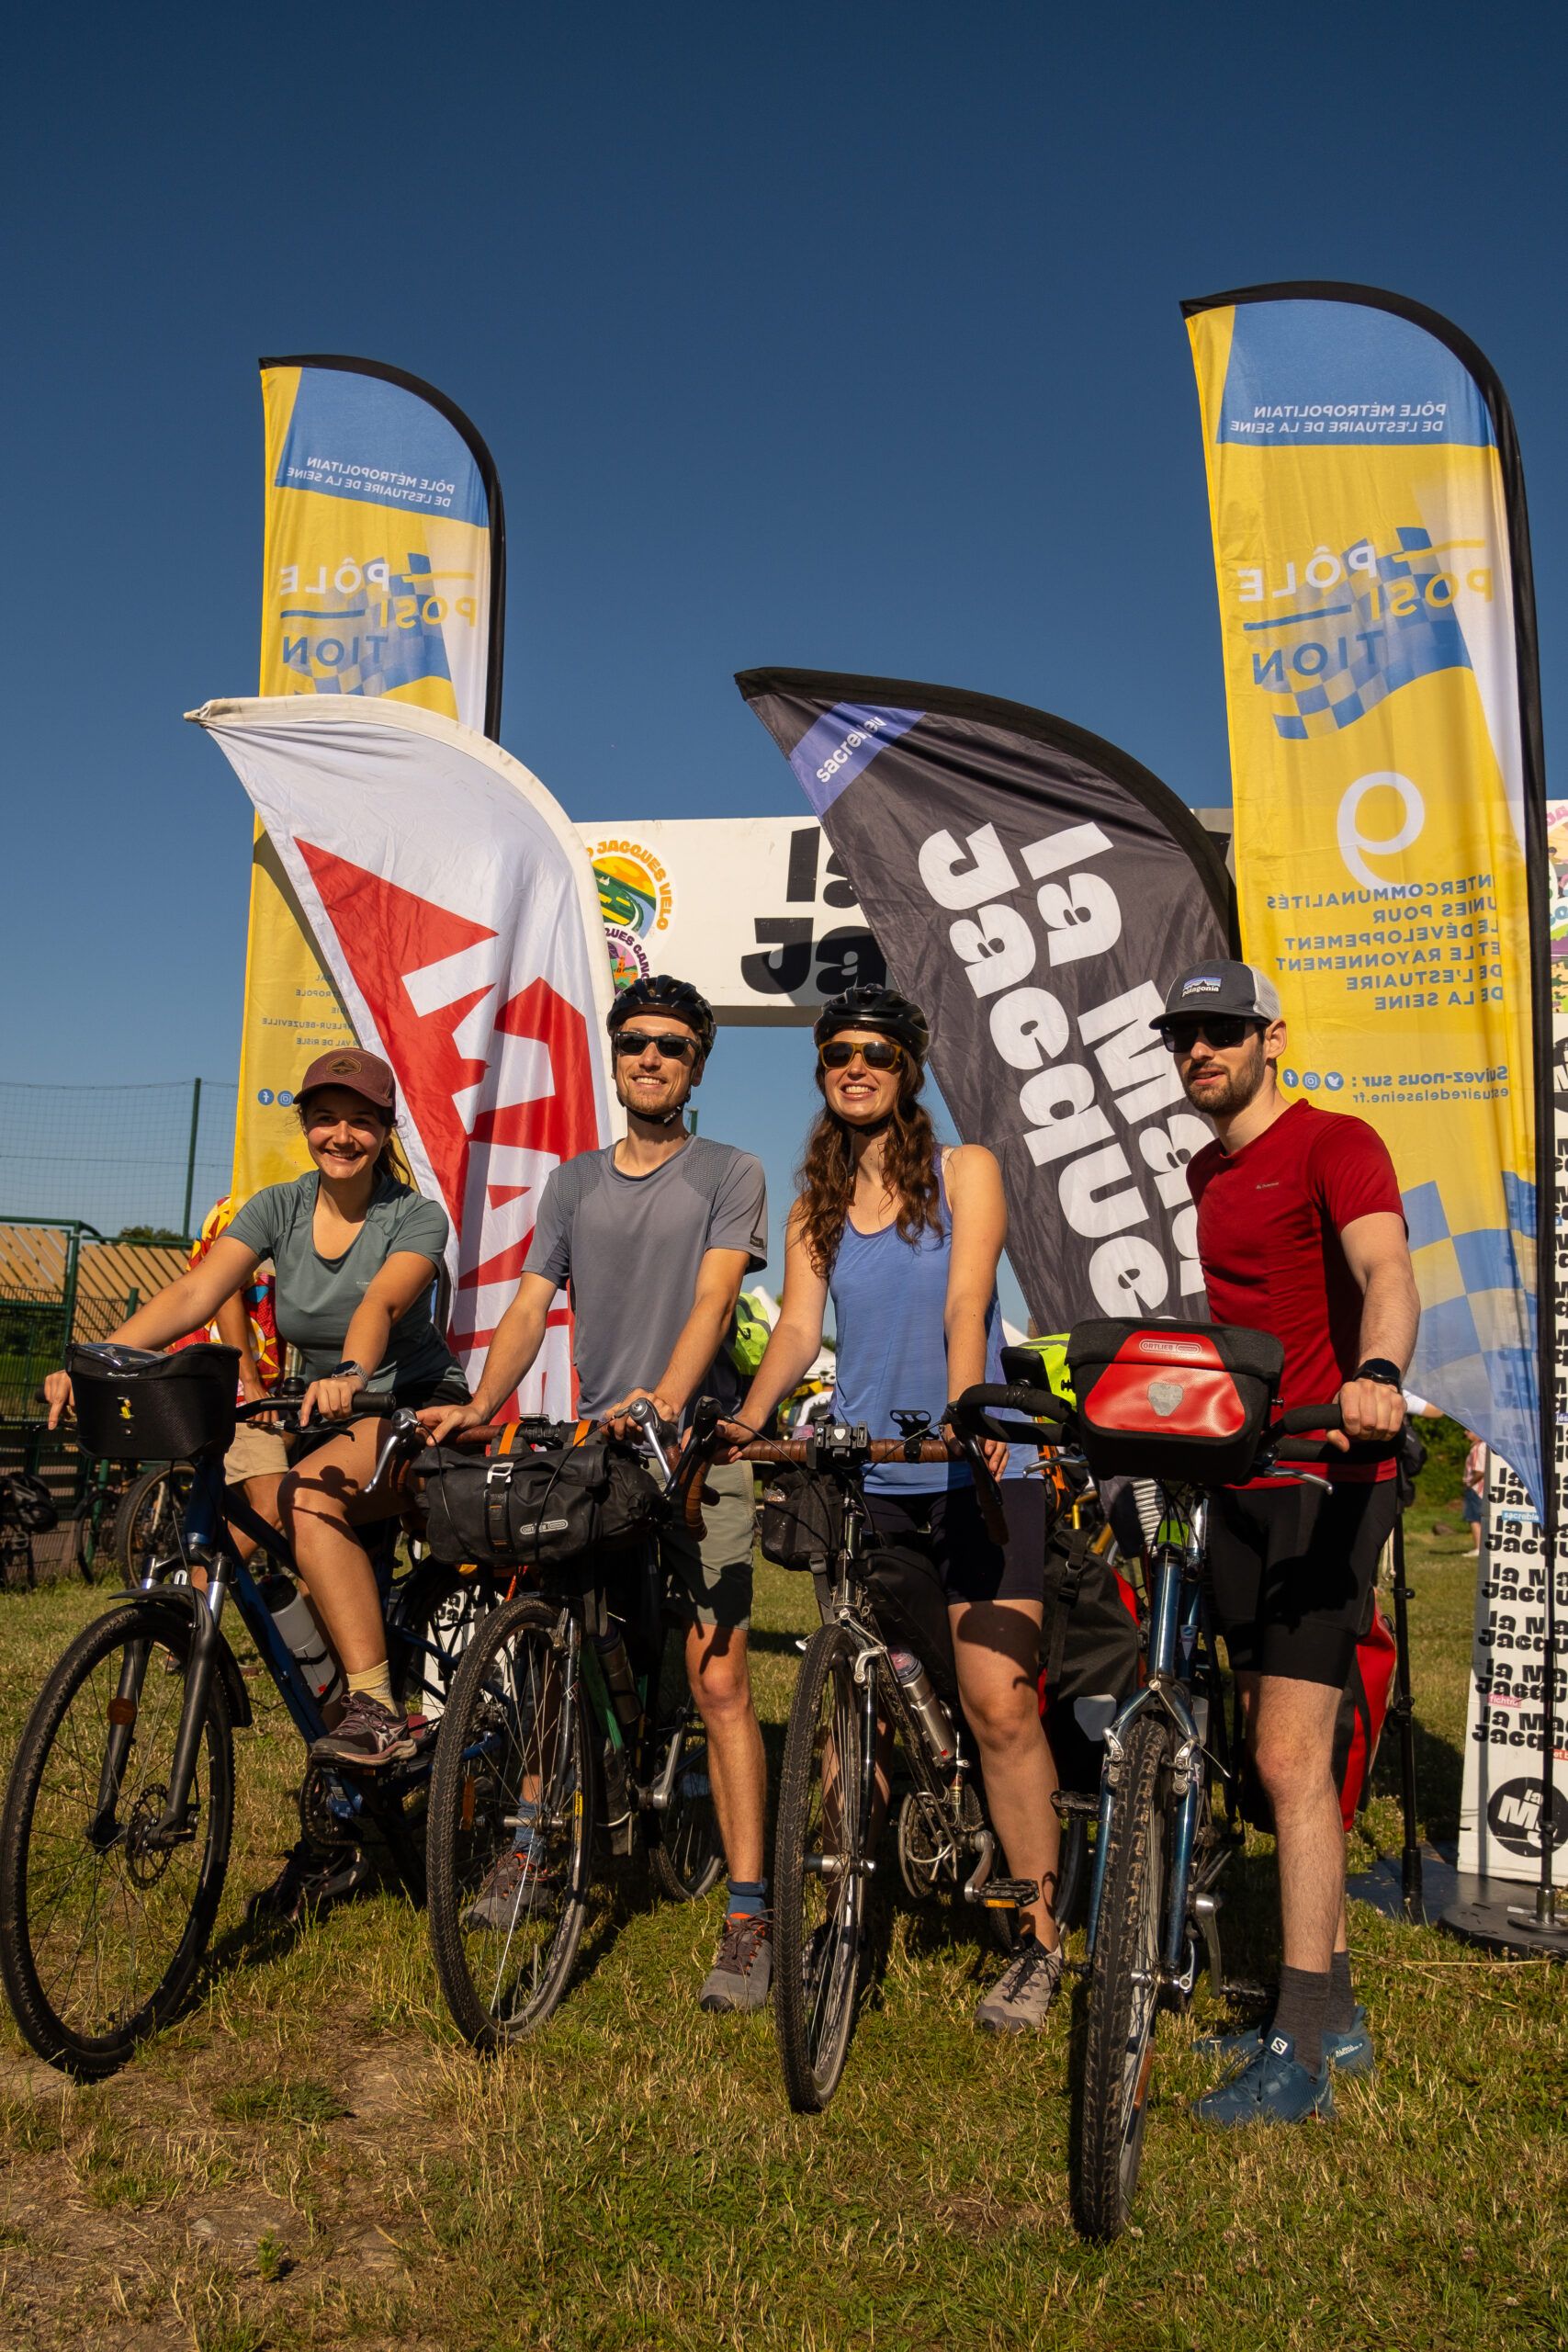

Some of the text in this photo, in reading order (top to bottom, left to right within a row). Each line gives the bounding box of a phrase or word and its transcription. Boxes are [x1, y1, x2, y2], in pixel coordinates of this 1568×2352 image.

[596, 841, 666, 882] JACQUES
[1020, 822, 1122, 967] la
[919, 822, 1179, 1321] Jacque
[1143, 1342, 1174, 1351] ORTLIEB
[1489, 1611, 1517, 1633] la
[1485, 1658, 1513, 1681] la
[1483, 1706, 1510, 1729] la
